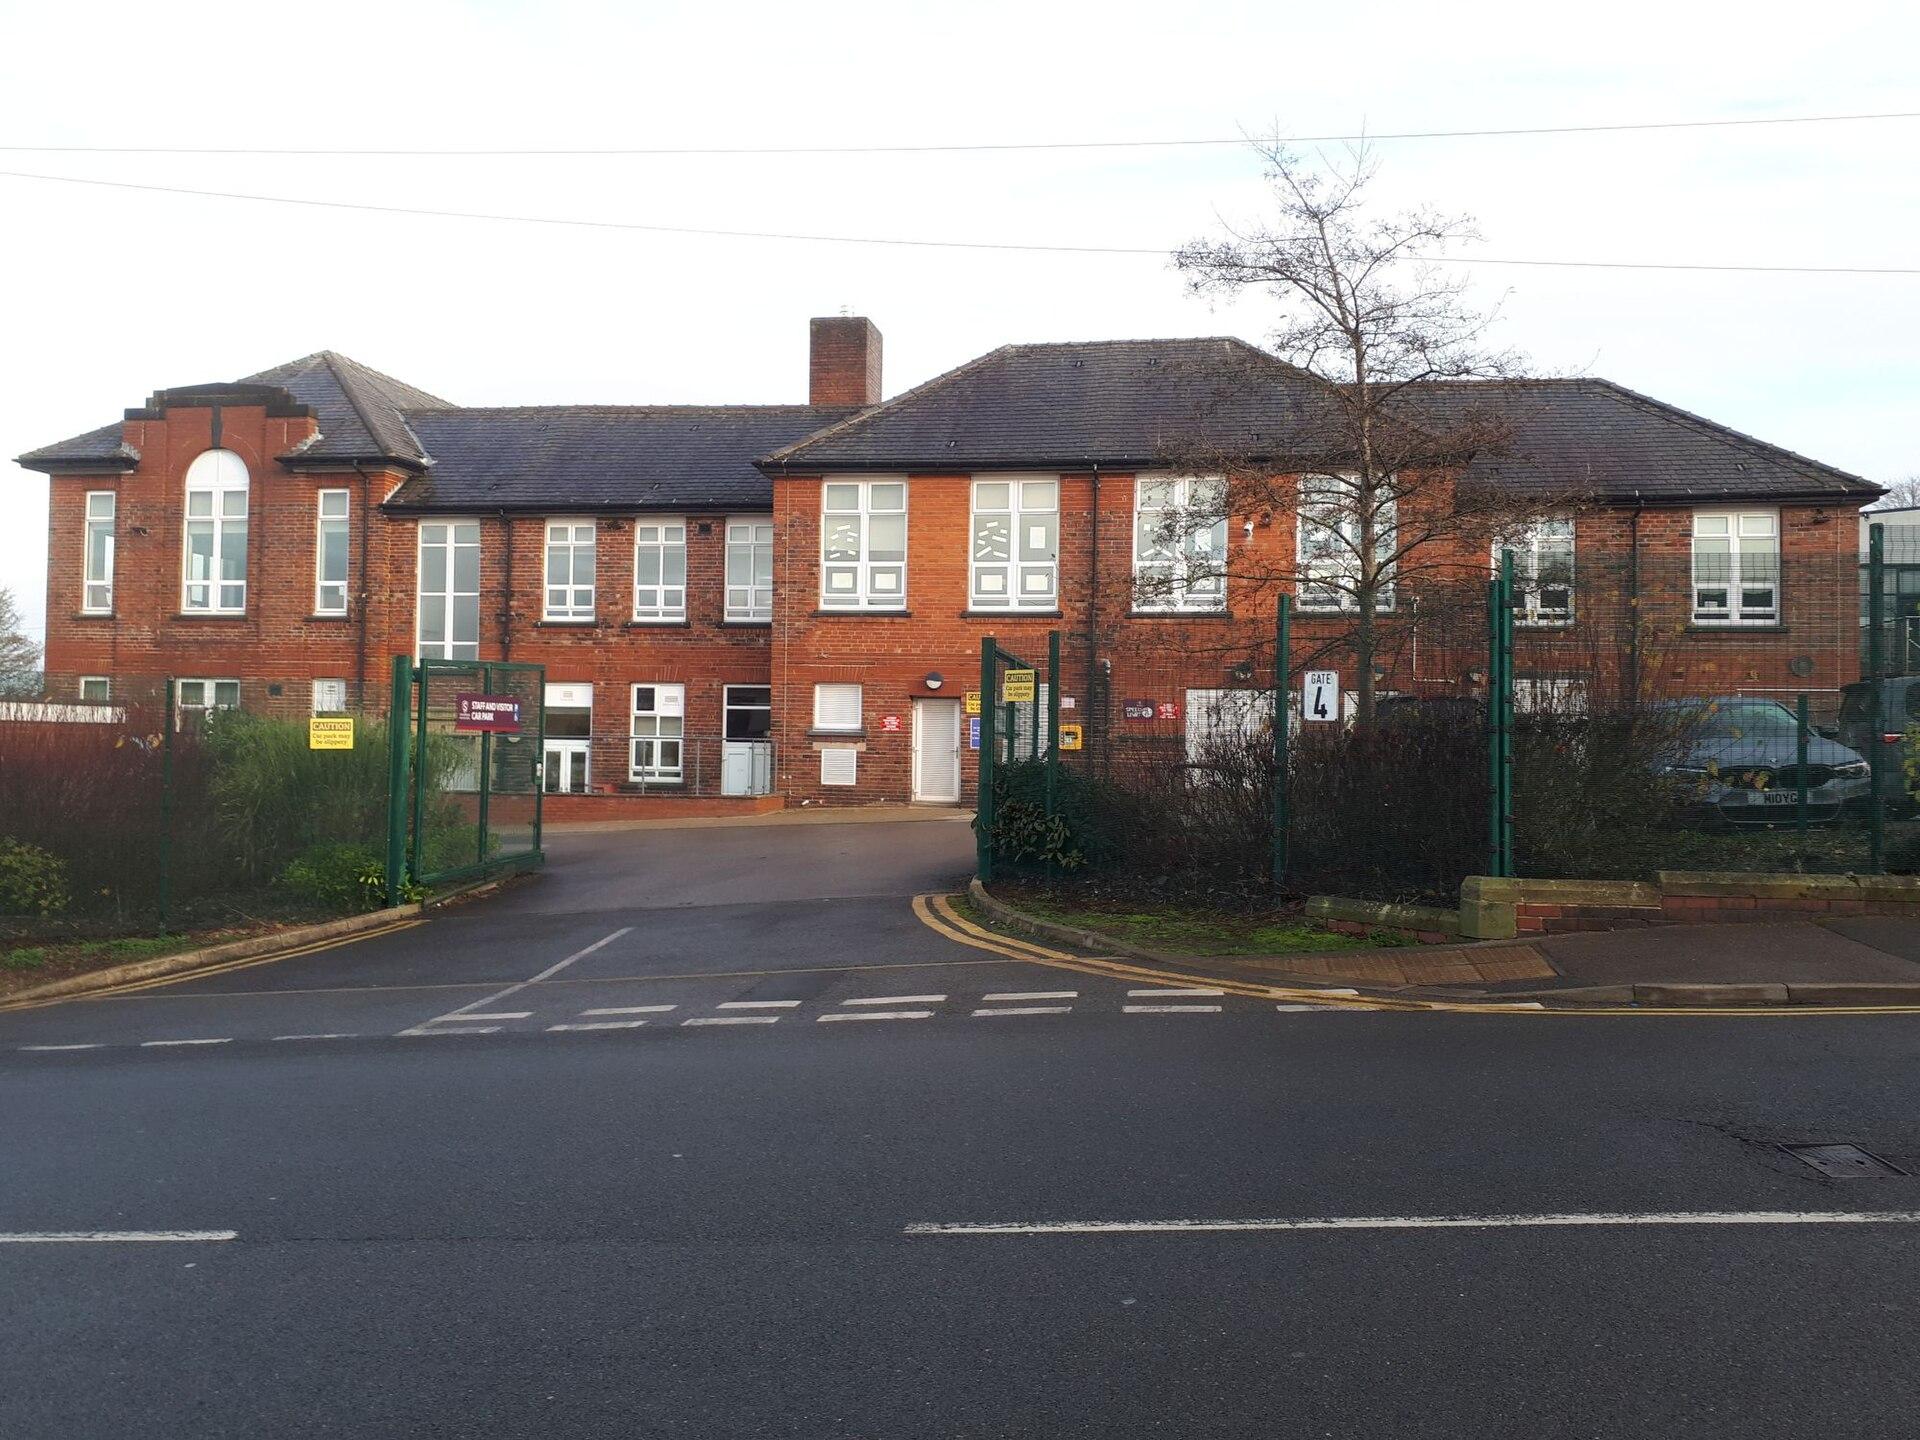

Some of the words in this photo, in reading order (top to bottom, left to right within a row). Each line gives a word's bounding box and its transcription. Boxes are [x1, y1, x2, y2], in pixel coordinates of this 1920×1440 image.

[1006, 674, 1032, 682] CAUTION
[1311, 673, 1331, 684] GATE
[471, 701, 485, 710] STAFF
[486, 702, 496, 710] AND
[497, 703, 513, 711] VISITOR
[1314, 686, 1328, 718] 4
[471, 711, 481, 720] CAR
[481, 712, 494, 721] PARK
[313, 722, 351, 730] CAUTION
